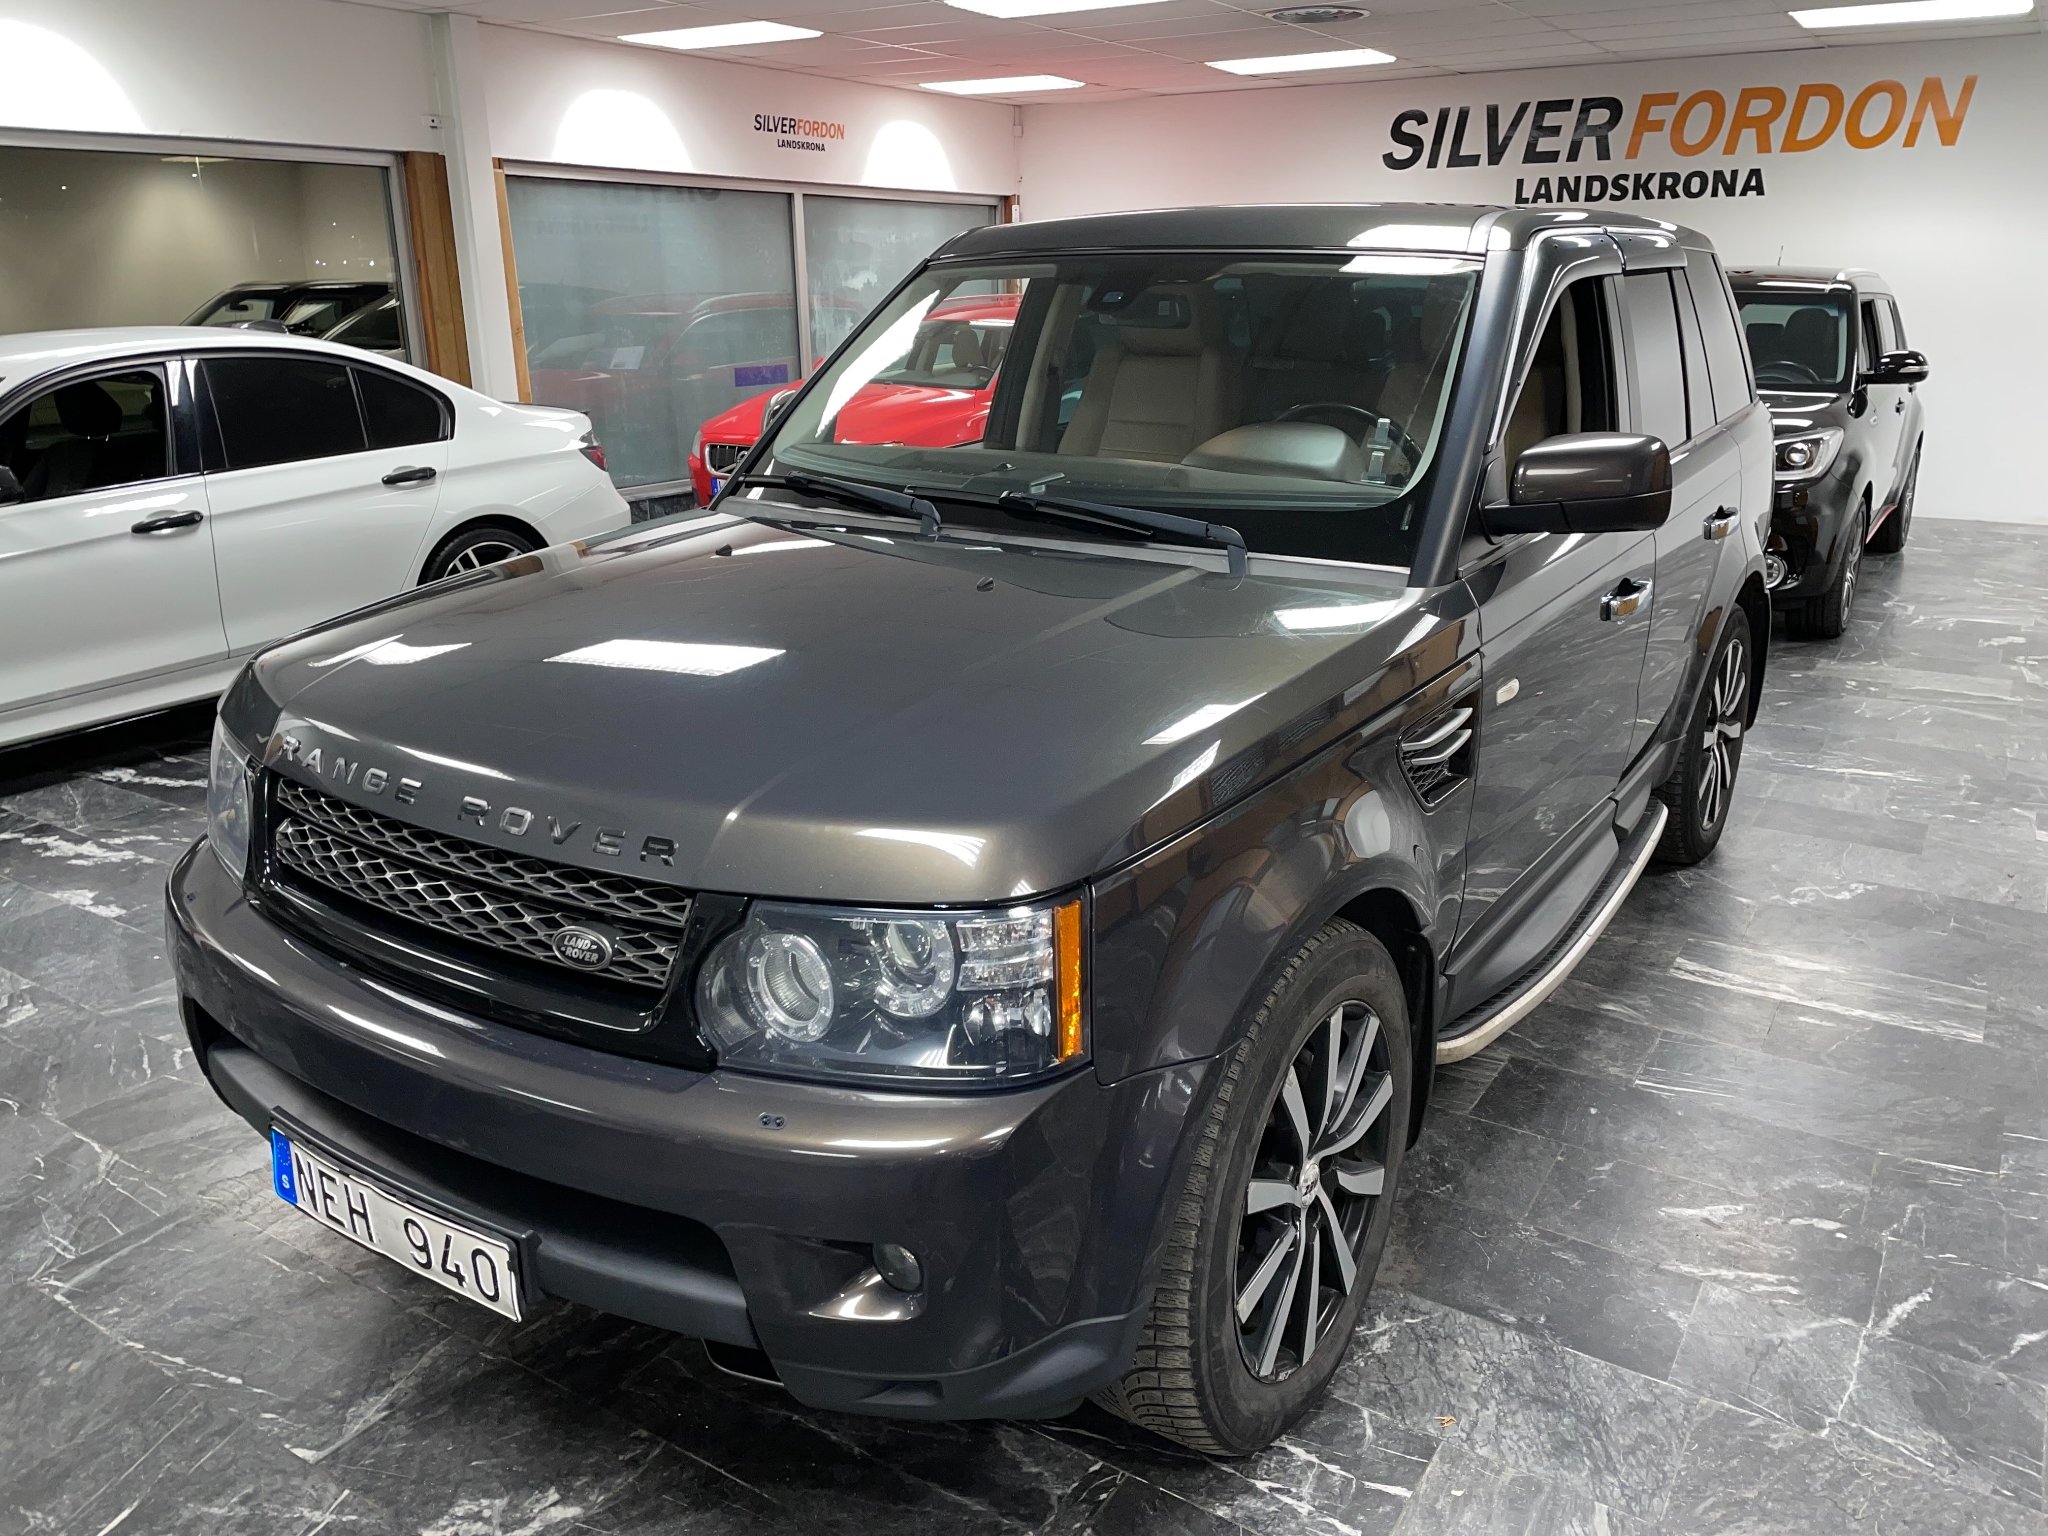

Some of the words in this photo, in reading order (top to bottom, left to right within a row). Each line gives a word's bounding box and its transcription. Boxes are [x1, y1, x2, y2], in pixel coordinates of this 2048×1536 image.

[754, 114, 844, 139] SILVERFORDON
[1382, 74, 1978, 170] SILVERFORDON
[777, 139, 826, 152] LANDSKRONA
[1515, 168, 1765, 205] LANDSKRONA
[284, 735, 422, 805] RANGE
[457, 795, 679, 867] ROVER
[281, 1174, 290, 1189] S
[295, 1151, 376, 1244] NEH
[403, 1217, 500, 1303] 940
